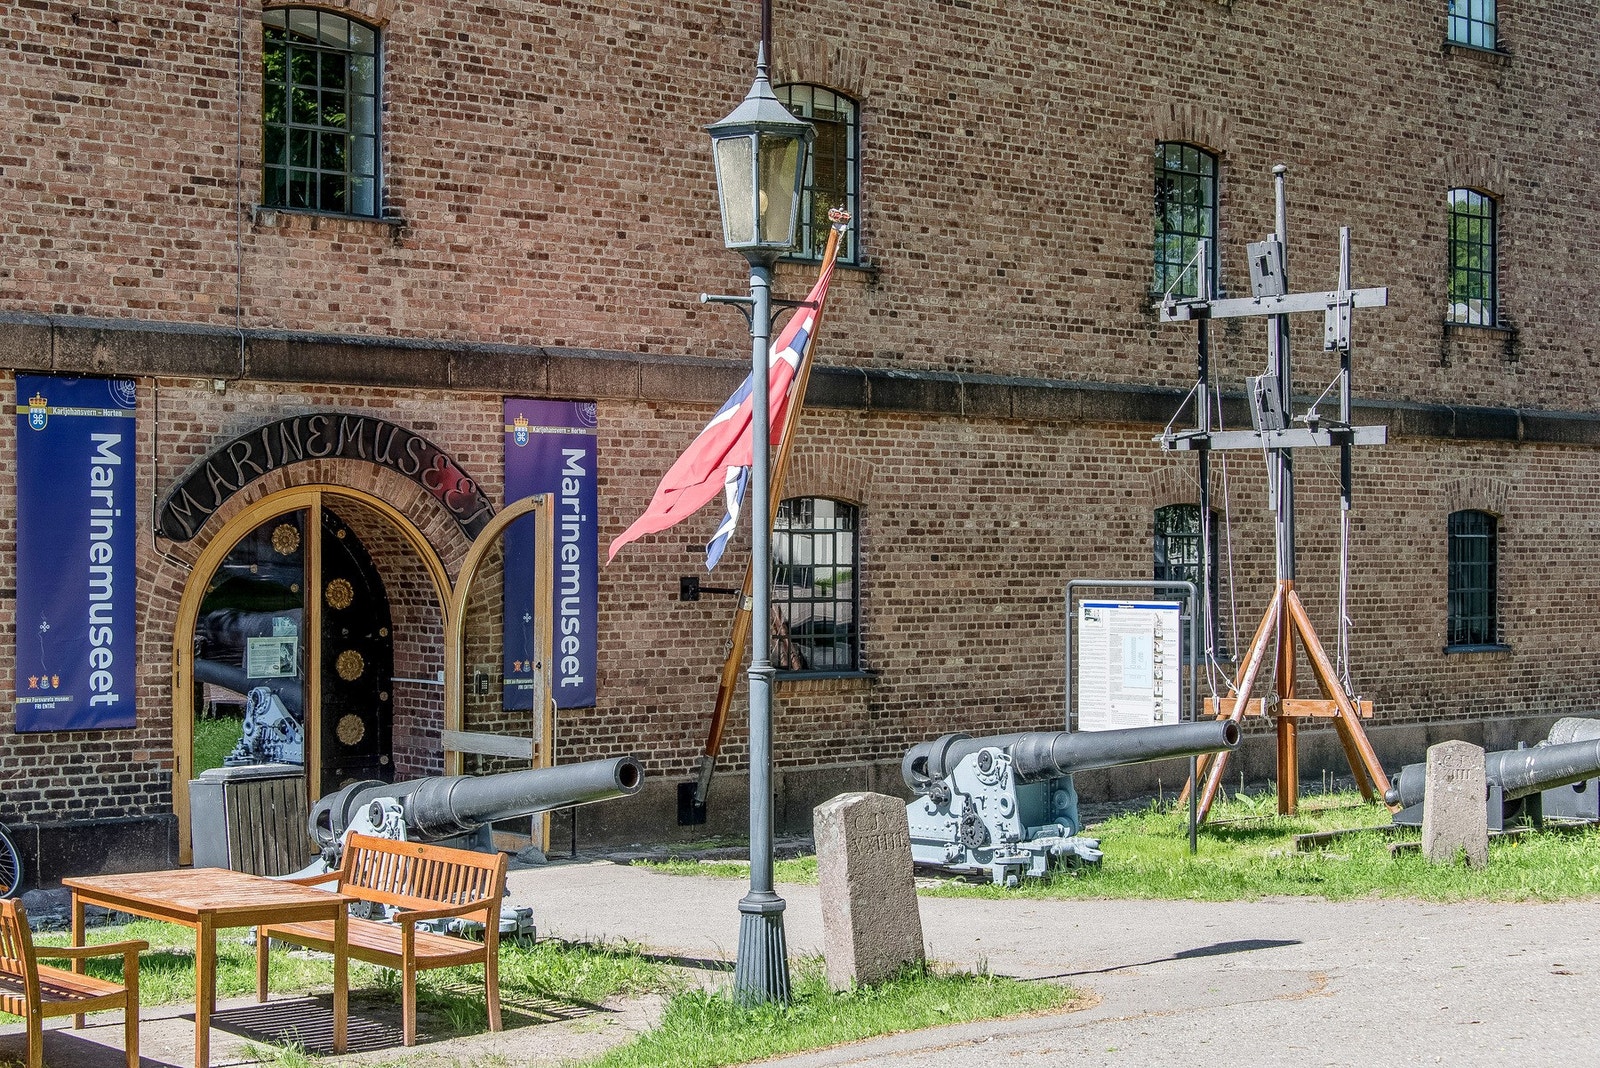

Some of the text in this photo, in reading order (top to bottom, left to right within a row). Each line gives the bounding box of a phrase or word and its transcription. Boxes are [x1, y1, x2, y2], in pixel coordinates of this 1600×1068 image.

[102, 408, 123, 417] Horten
[168, 414, 496, 538] MARINEMUSEET
[89, 433, 122, 707] Marinemuseet
[560, 449, 586, 688] Marinemuseet
